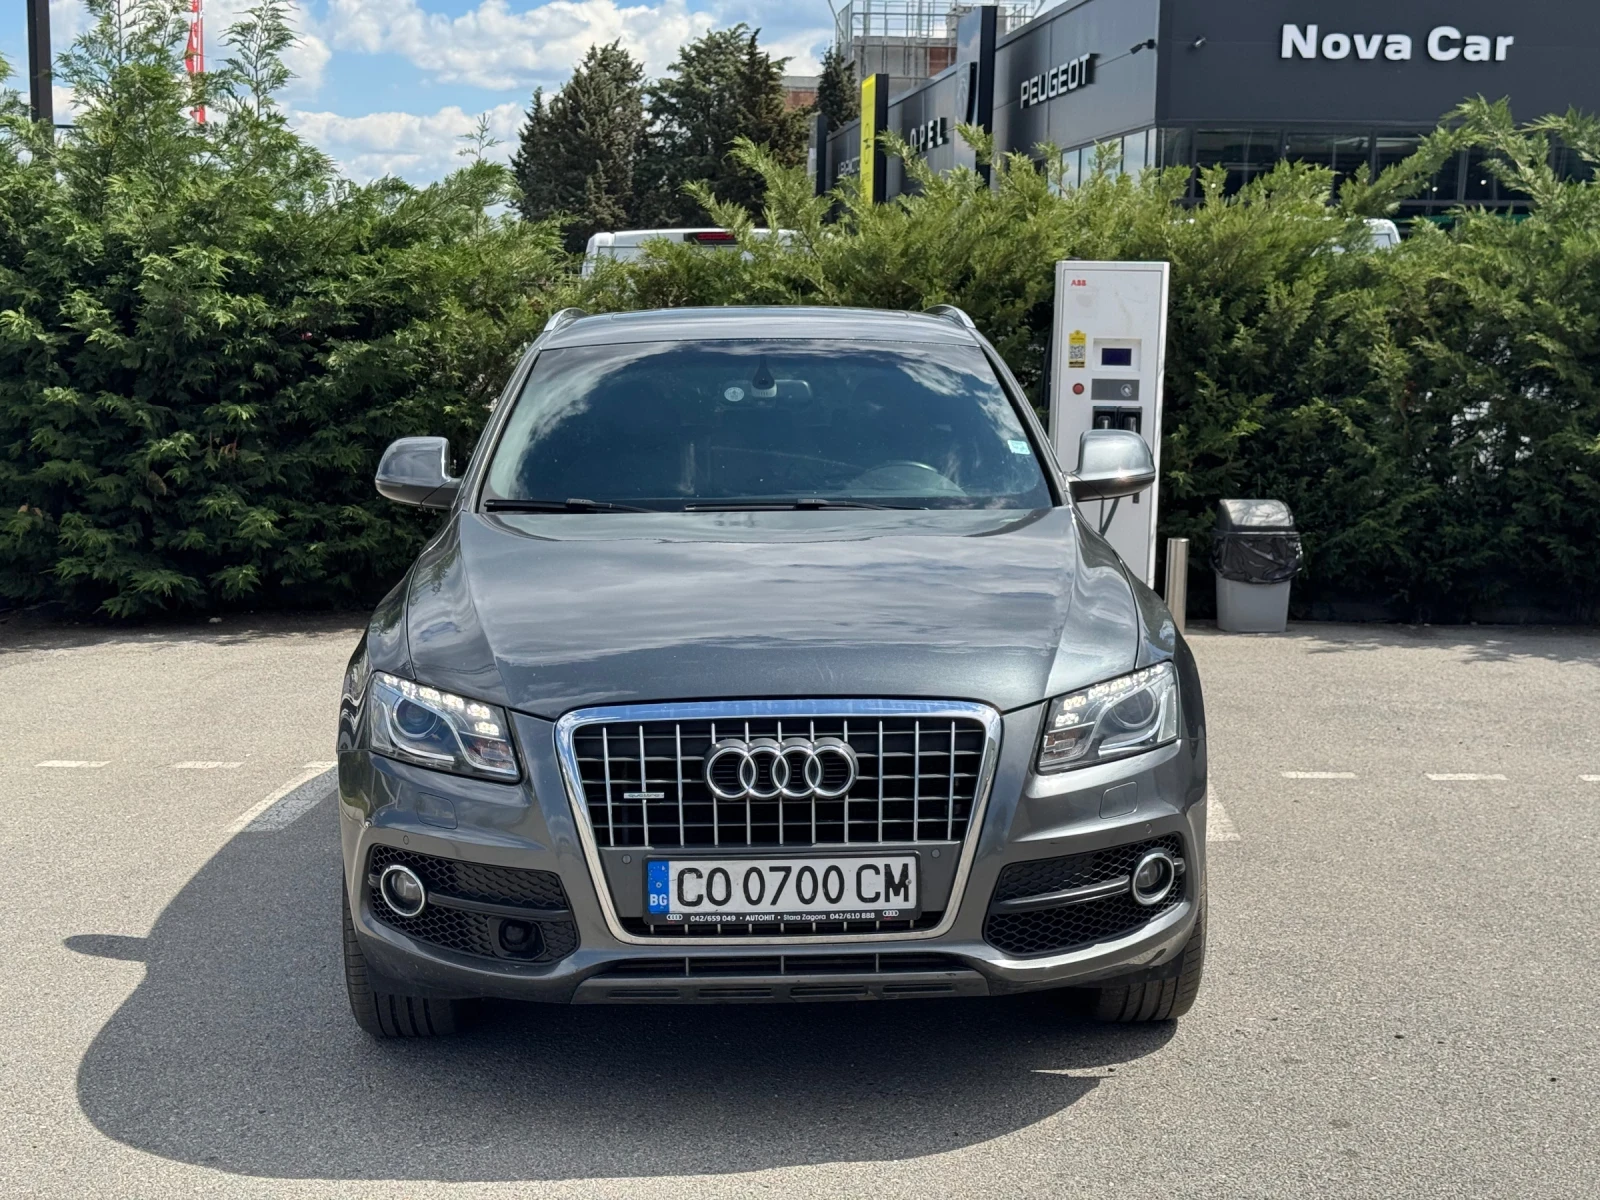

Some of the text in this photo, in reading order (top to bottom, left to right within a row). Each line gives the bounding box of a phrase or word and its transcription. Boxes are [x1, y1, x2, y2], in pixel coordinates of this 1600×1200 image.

[1281, 24, 1514, 61] Nova Car
[1020, 52, 1090, 109] PEUGEOT
[910, 116, 943, 152] OPEL
[649, 894, 668, 906] BG
[677, 863, 910, 907] CO 0700 CM
[723, 914, 736, 922] 049
[802, 913, 826, 922] Zagora
[829, 912, 860, 920] 042/610
